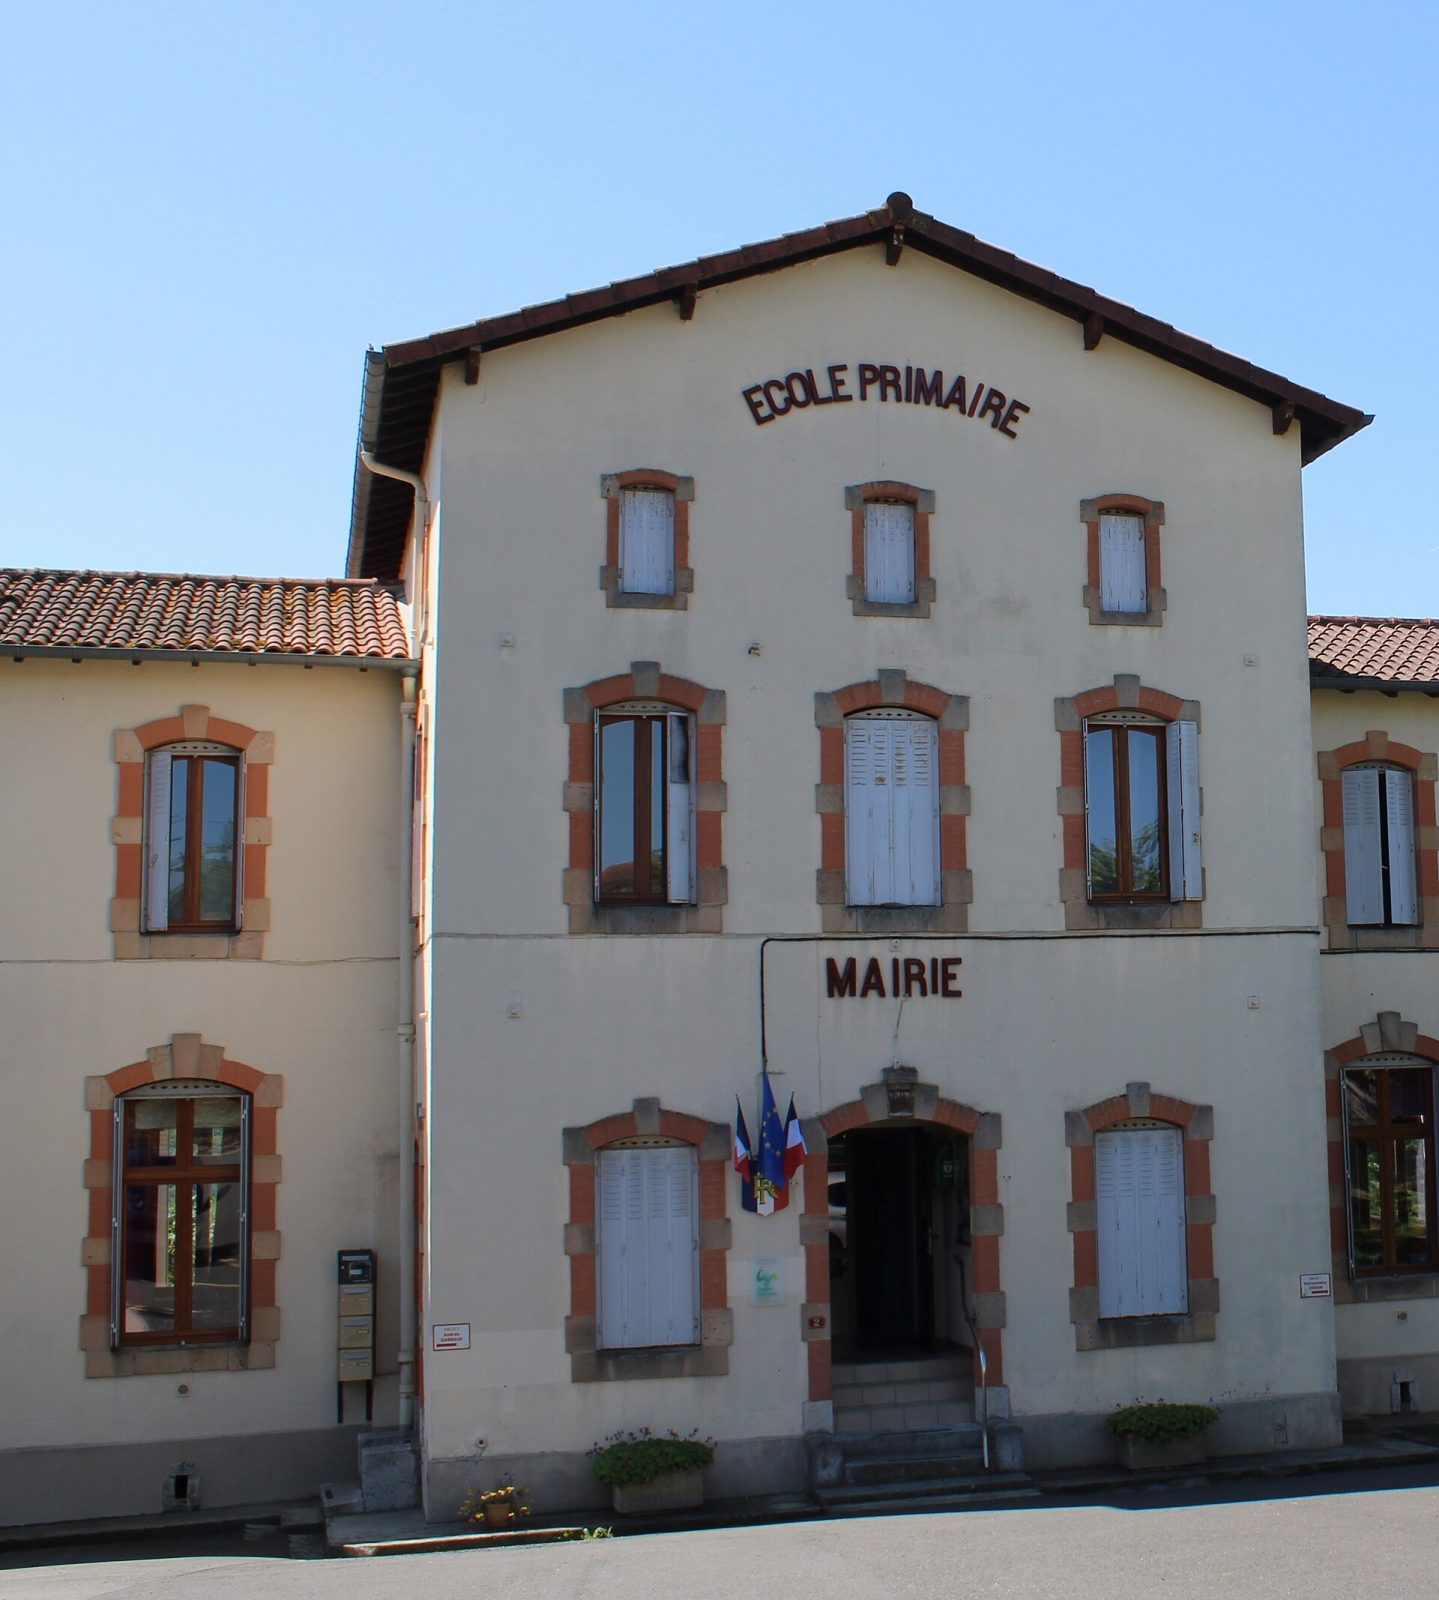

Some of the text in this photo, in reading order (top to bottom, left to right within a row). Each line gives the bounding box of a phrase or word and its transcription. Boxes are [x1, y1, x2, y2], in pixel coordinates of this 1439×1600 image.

[742, 363, 1031, 439] ECOLE PRIMAIRE
[825, 956, 963, 999] MAIRIE
